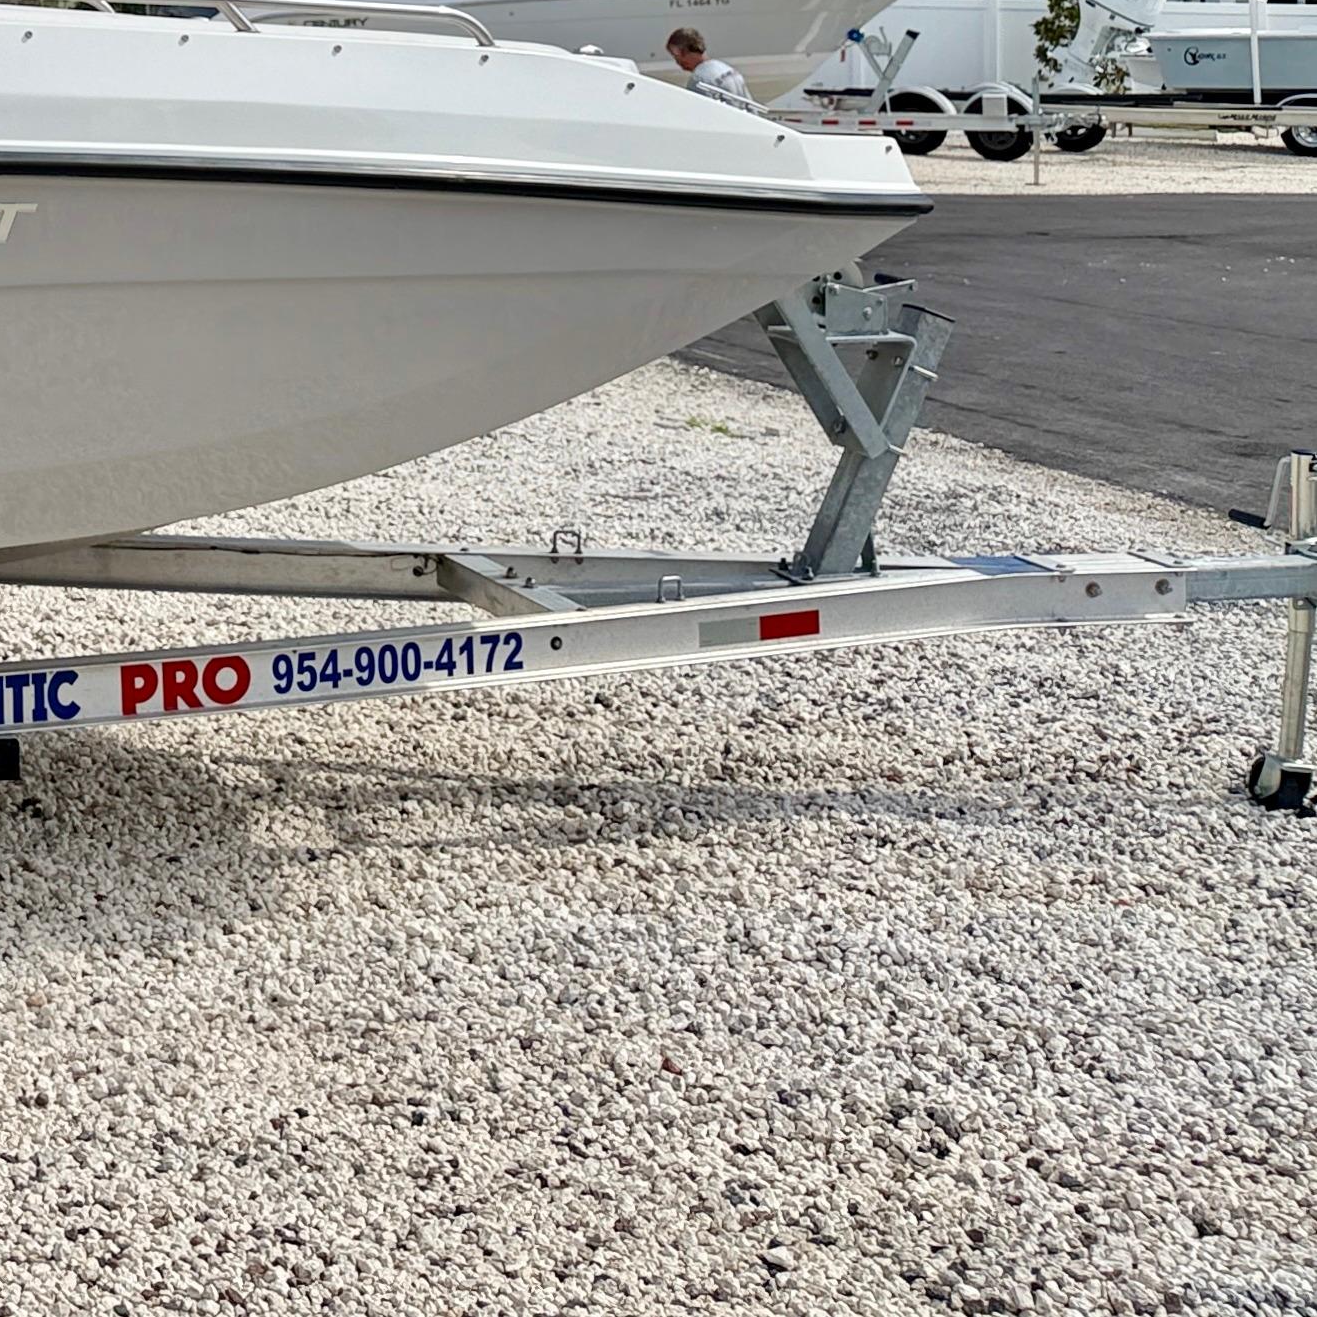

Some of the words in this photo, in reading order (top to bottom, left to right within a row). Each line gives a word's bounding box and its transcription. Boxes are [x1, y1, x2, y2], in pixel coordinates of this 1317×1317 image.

[669, 0, 683, 8] FL
[119, 654, 251, 716] PRO
[272, 631, 524, 695] 954-900-4172
